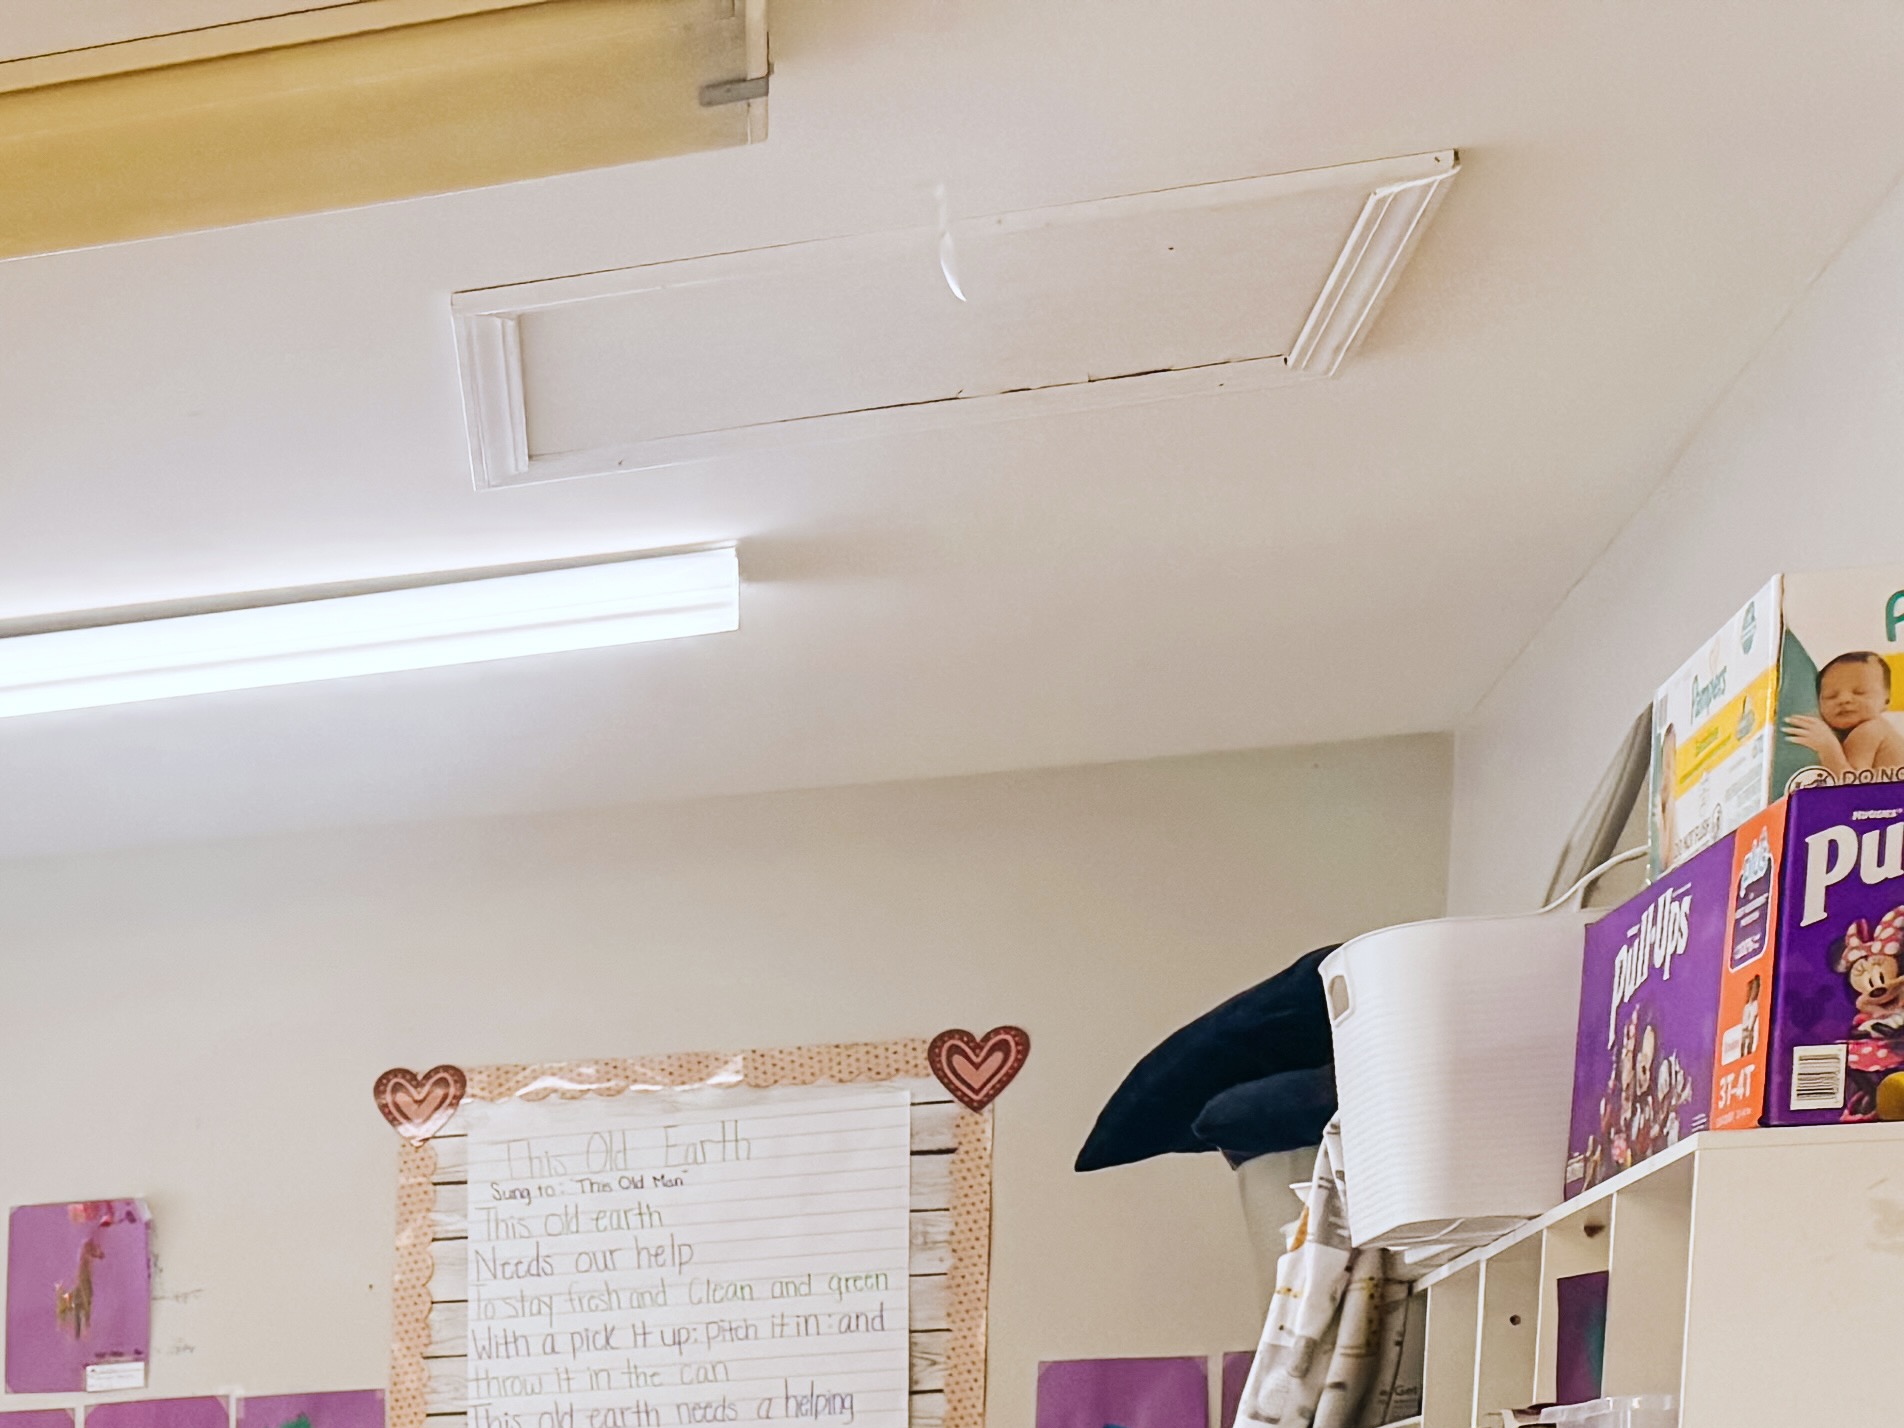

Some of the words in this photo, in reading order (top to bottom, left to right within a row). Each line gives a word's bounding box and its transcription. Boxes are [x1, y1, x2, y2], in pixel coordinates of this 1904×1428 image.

[494, 1138, 567, 1179] This
[587, 1129, 629, 1174] Old
[663, 1120, 752, 1168] Earth
[491, 1182, 533, 1205] Sung
[618, 1174, 644, 1190] Old
[475, 1206, 533, 1242] This
[544, 1203, 580, 1237] old
[592, 1200, 664, 1230] earth
[474, 1241, 555, 1281] Needs
[575, 1248, 620, 1273] our
[634, 1232, 695, 1276] help
[567, 1280, 622, 1314] fresh
[629, 1276, 668, 1310] and
[771, 1273, 813, 1299] and
[828, 1271, 890, 1302] green
[471, 1325, 531, 1360] With
[542, 1332, 561, 1356] a
[570, 1321, 622, 1360] pick
[838, 1301, 886, 1334] and
[468, 1366, 543, 1400] throw
[587, 1366, 612, 1392] in
[621, 1357, 664, 1388] the
[679, 1360, 730, 1387] can
[675, 1395, 739, 1426] needs
[756, 1396, 774, 1421] a
[784, 1376, 856, 1426] helping
